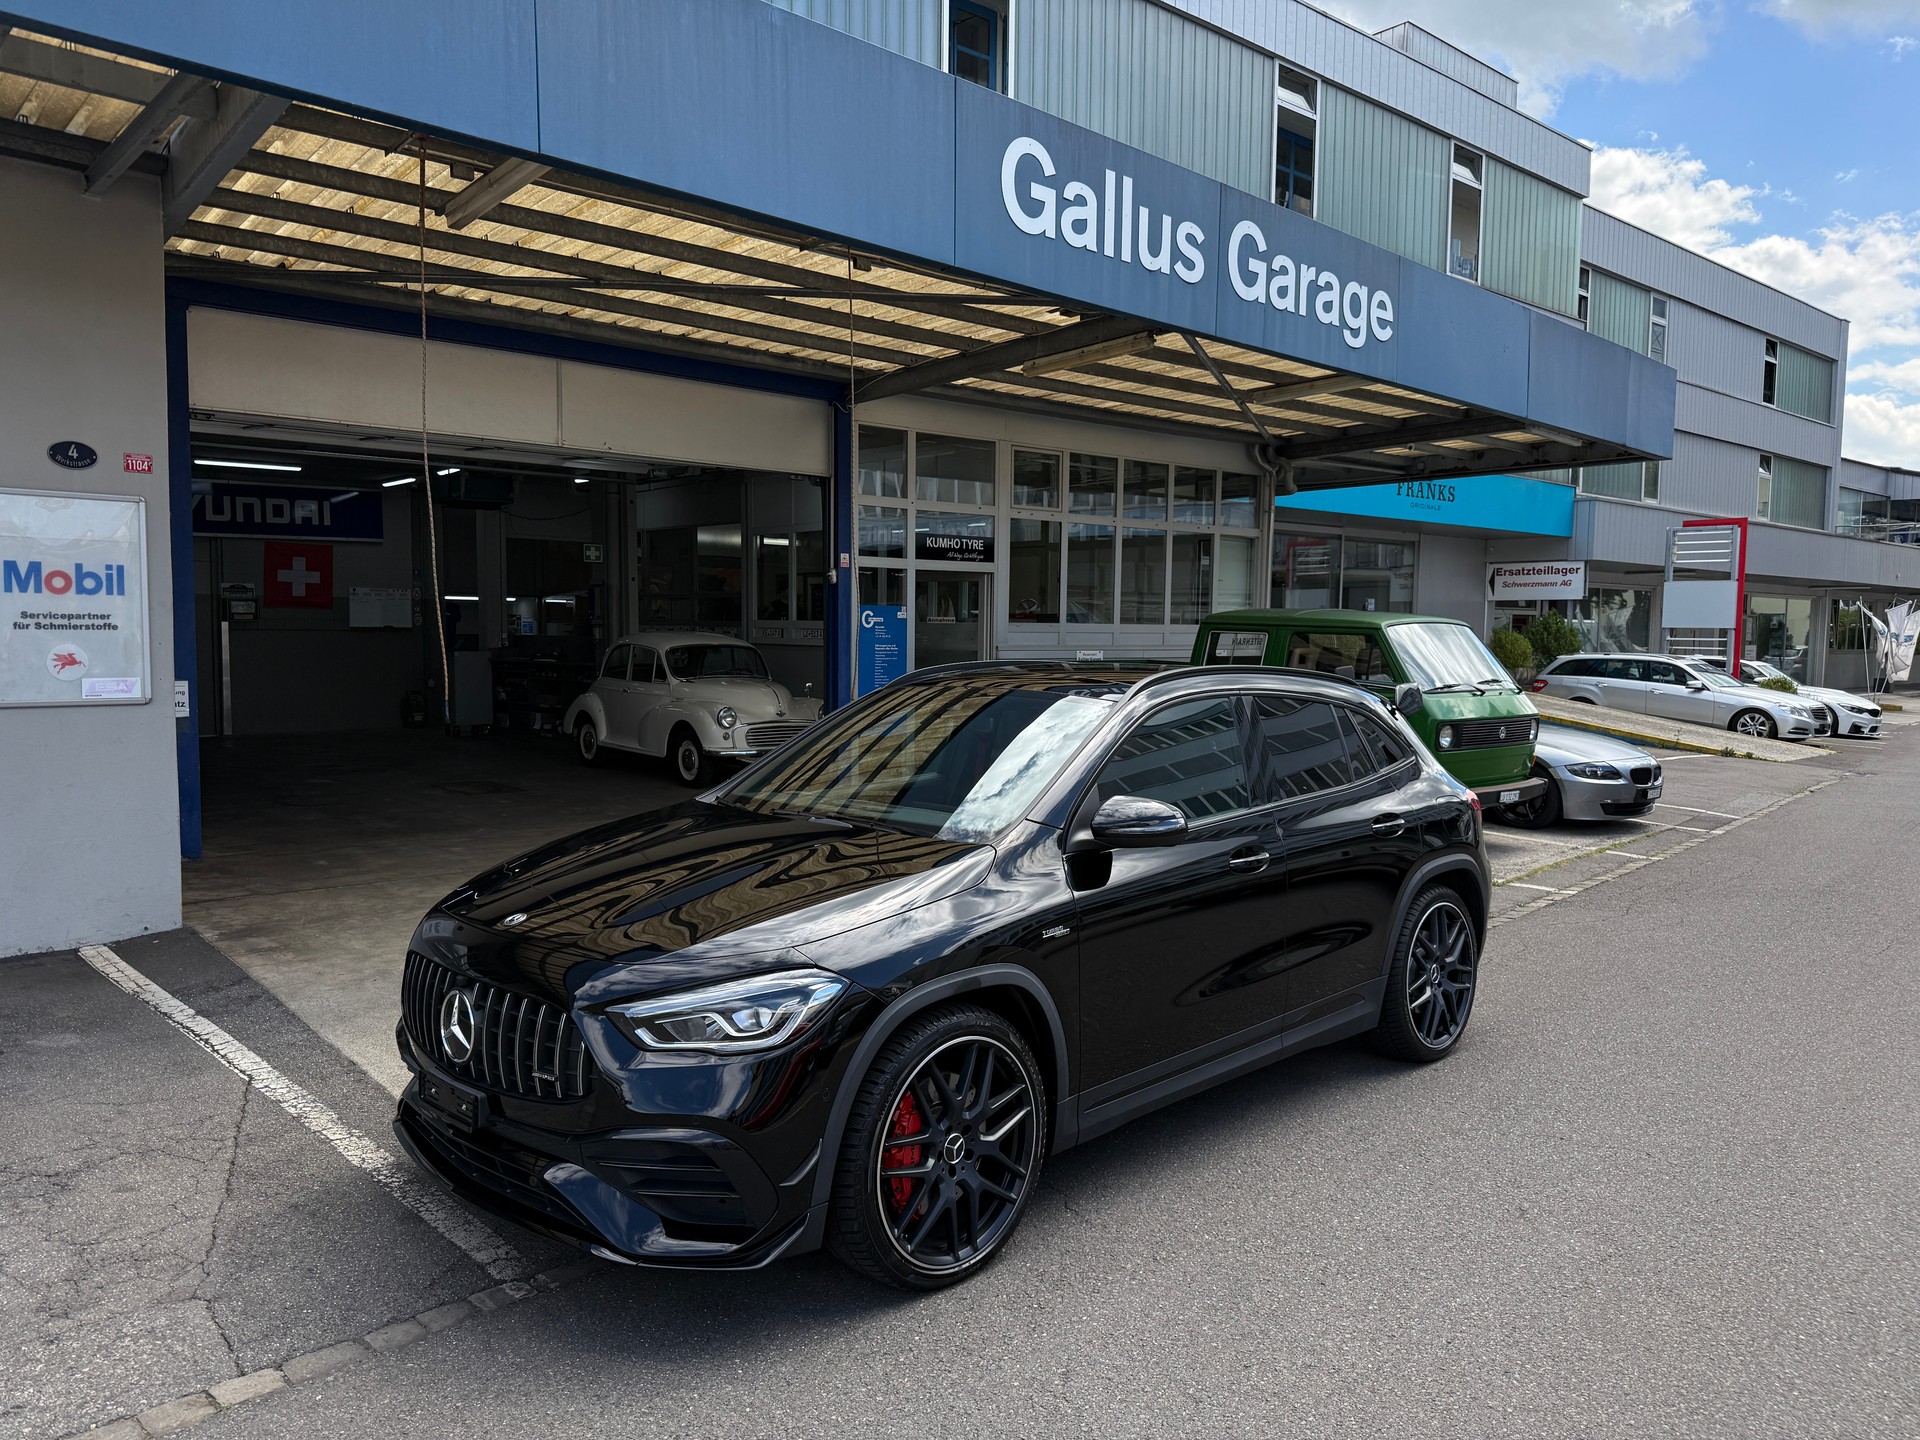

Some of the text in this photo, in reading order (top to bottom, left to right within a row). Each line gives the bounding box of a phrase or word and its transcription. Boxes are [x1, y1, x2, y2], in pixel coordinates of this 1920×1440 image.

[1001, 136, 1394, 349] Gallus Garage
[68, 444, 79, 459] 4
[128, 460, 149, 471] 1104
[1396, 481, 1456, 503] FRANKS
[926, 536, 985, 550] KUMHO TYRE
[3, 559, 126, 596] Mobil
[1495, 565, 1582, 577] Ersatzteillager
[1502, 579, 1573, 588] Schwerzmann AG
[19, 610, 113, 621] Servicepartner
[12, 621, 119, 631] für Schmierstoffe
